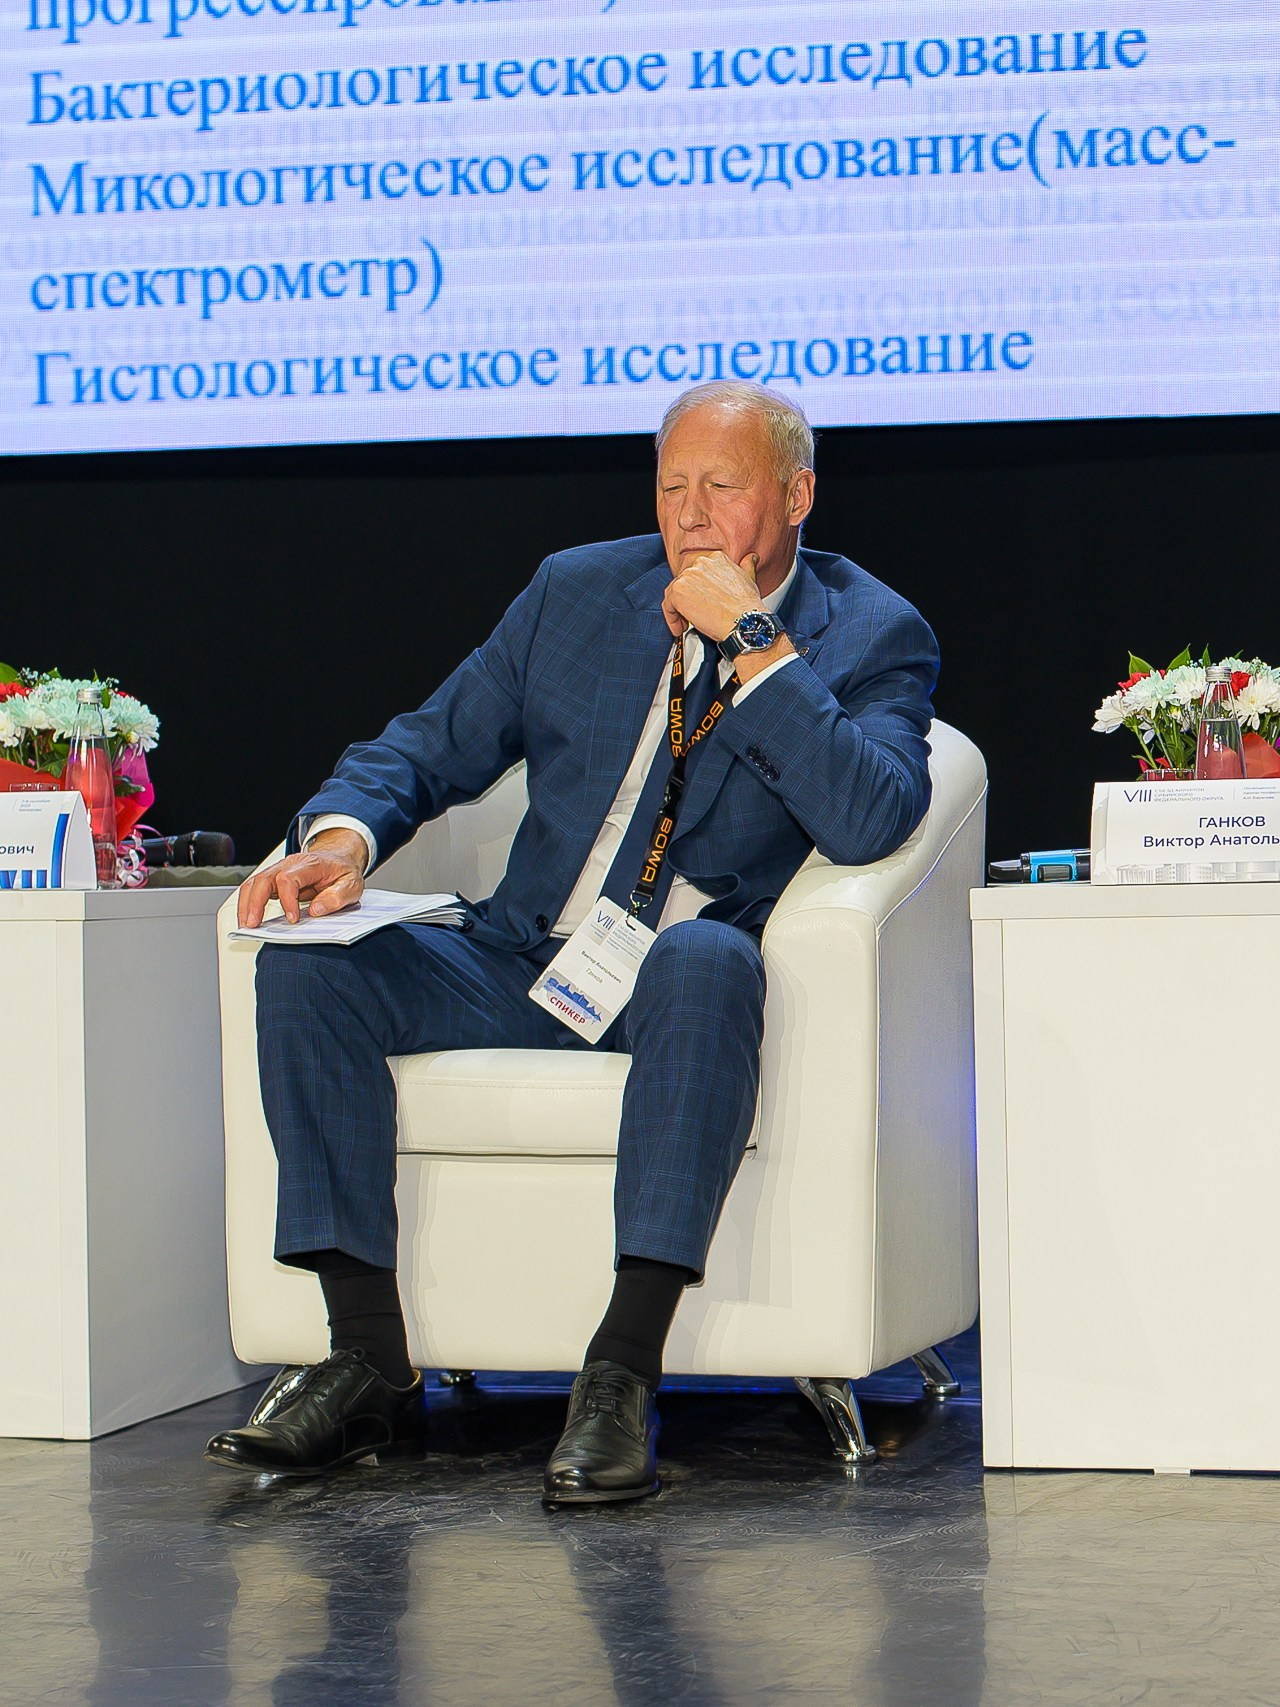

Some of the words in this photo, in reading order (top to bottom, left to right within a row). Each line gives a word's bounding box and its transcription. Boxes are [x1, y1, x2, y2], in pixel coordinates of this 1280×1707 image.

[27, 52, 668, 133] Бактериологическое
[688, 29, 1148, 93] исследование
[28, 153, 550, 218] Микологическое
[571, 112, 1236, 192] исследование(масс-
[29, 236, 444, 321] спектрометр)
[32, 348, 559, 407] Гистологическое
[580, 331, 1034, 386] исследование
[670, 697, 682, 758] BOWA
[1124, 789, 1152, 803] VIII
[1199, 815, 1266, 828] ГАНКОВ
[642, 817, 673, 882] BOWA
[1143, 835, 1204, 848] Виктор
[598, 910, 616, 931] VIII
[550, 996, 586, 1024] СПИКЕР
